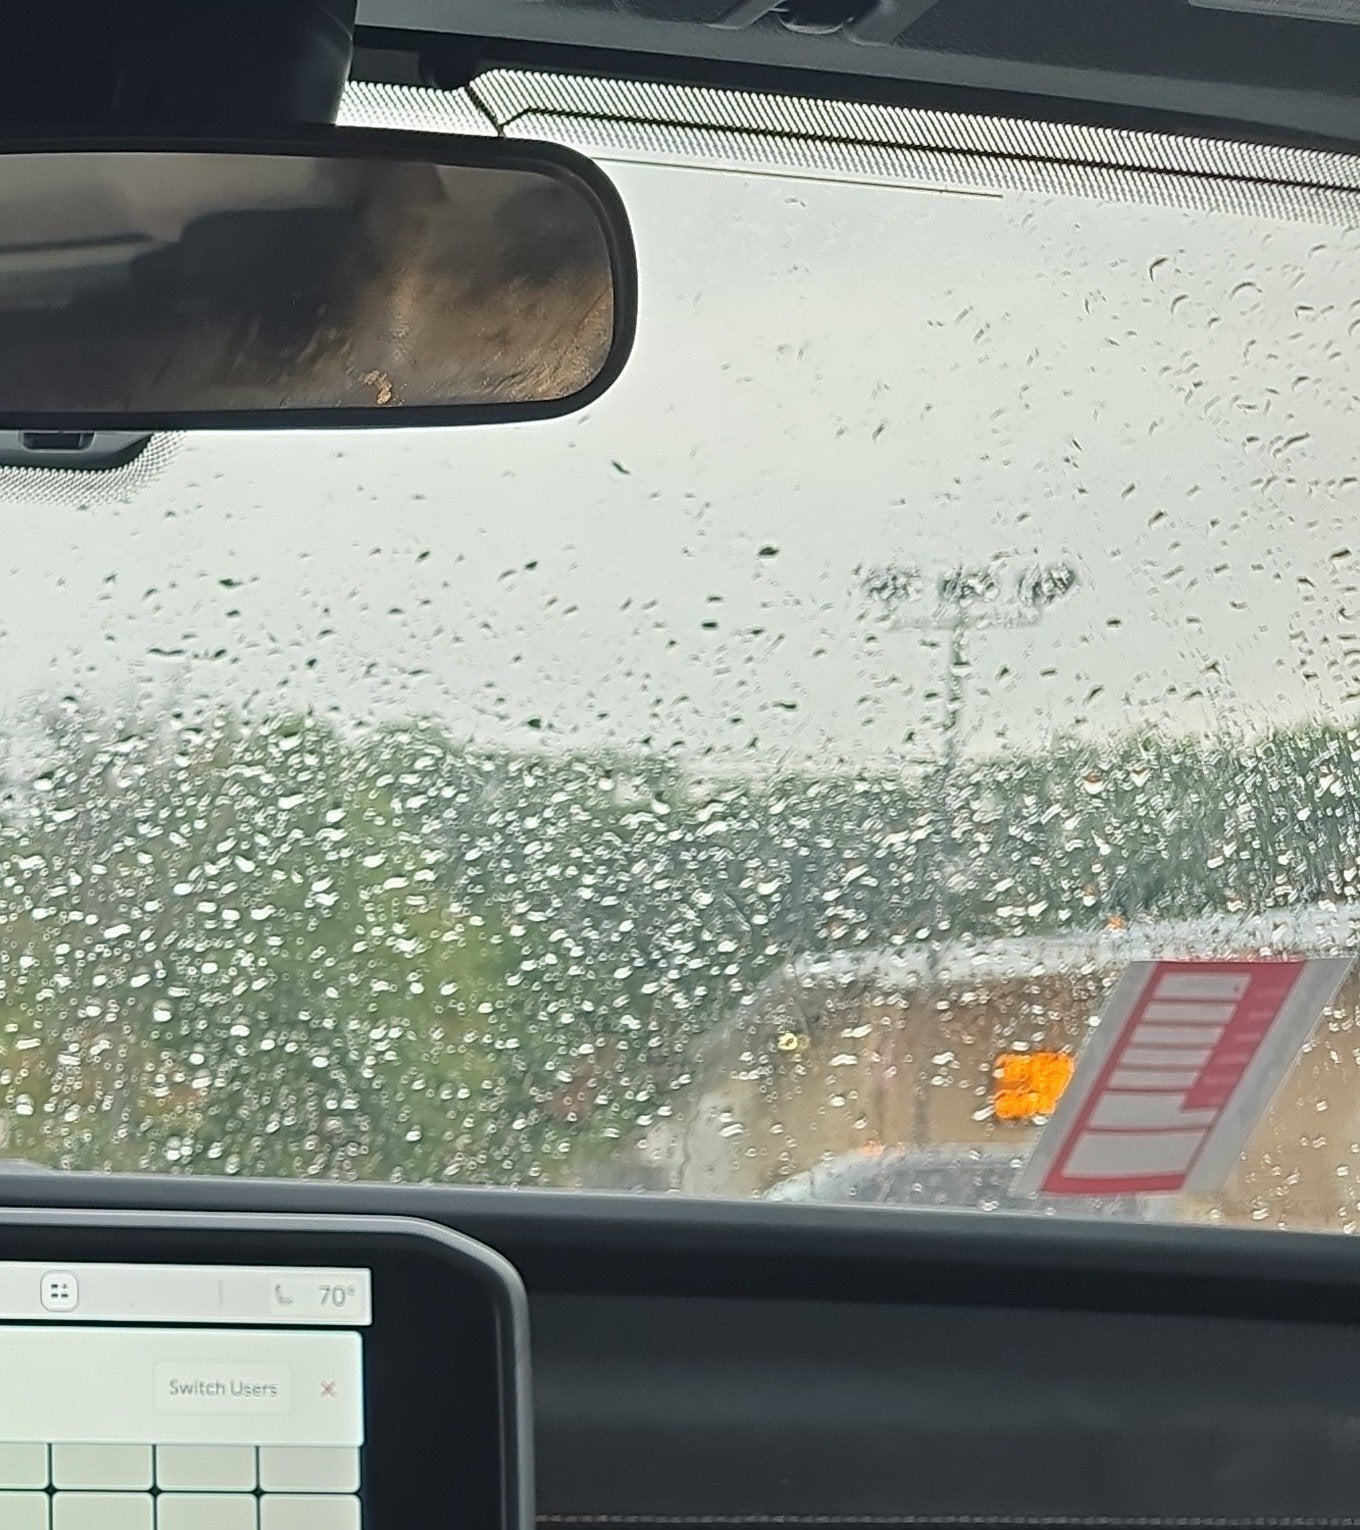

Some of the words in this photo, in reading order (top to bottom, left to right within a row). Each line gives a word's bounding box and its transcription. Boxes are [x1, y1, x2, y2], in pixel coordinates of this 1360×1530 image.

[319, 1284, 356, 1308] 70°
[168, 1378, 227, 1397] Switch
[230, 1380, 279, 1399] Users
